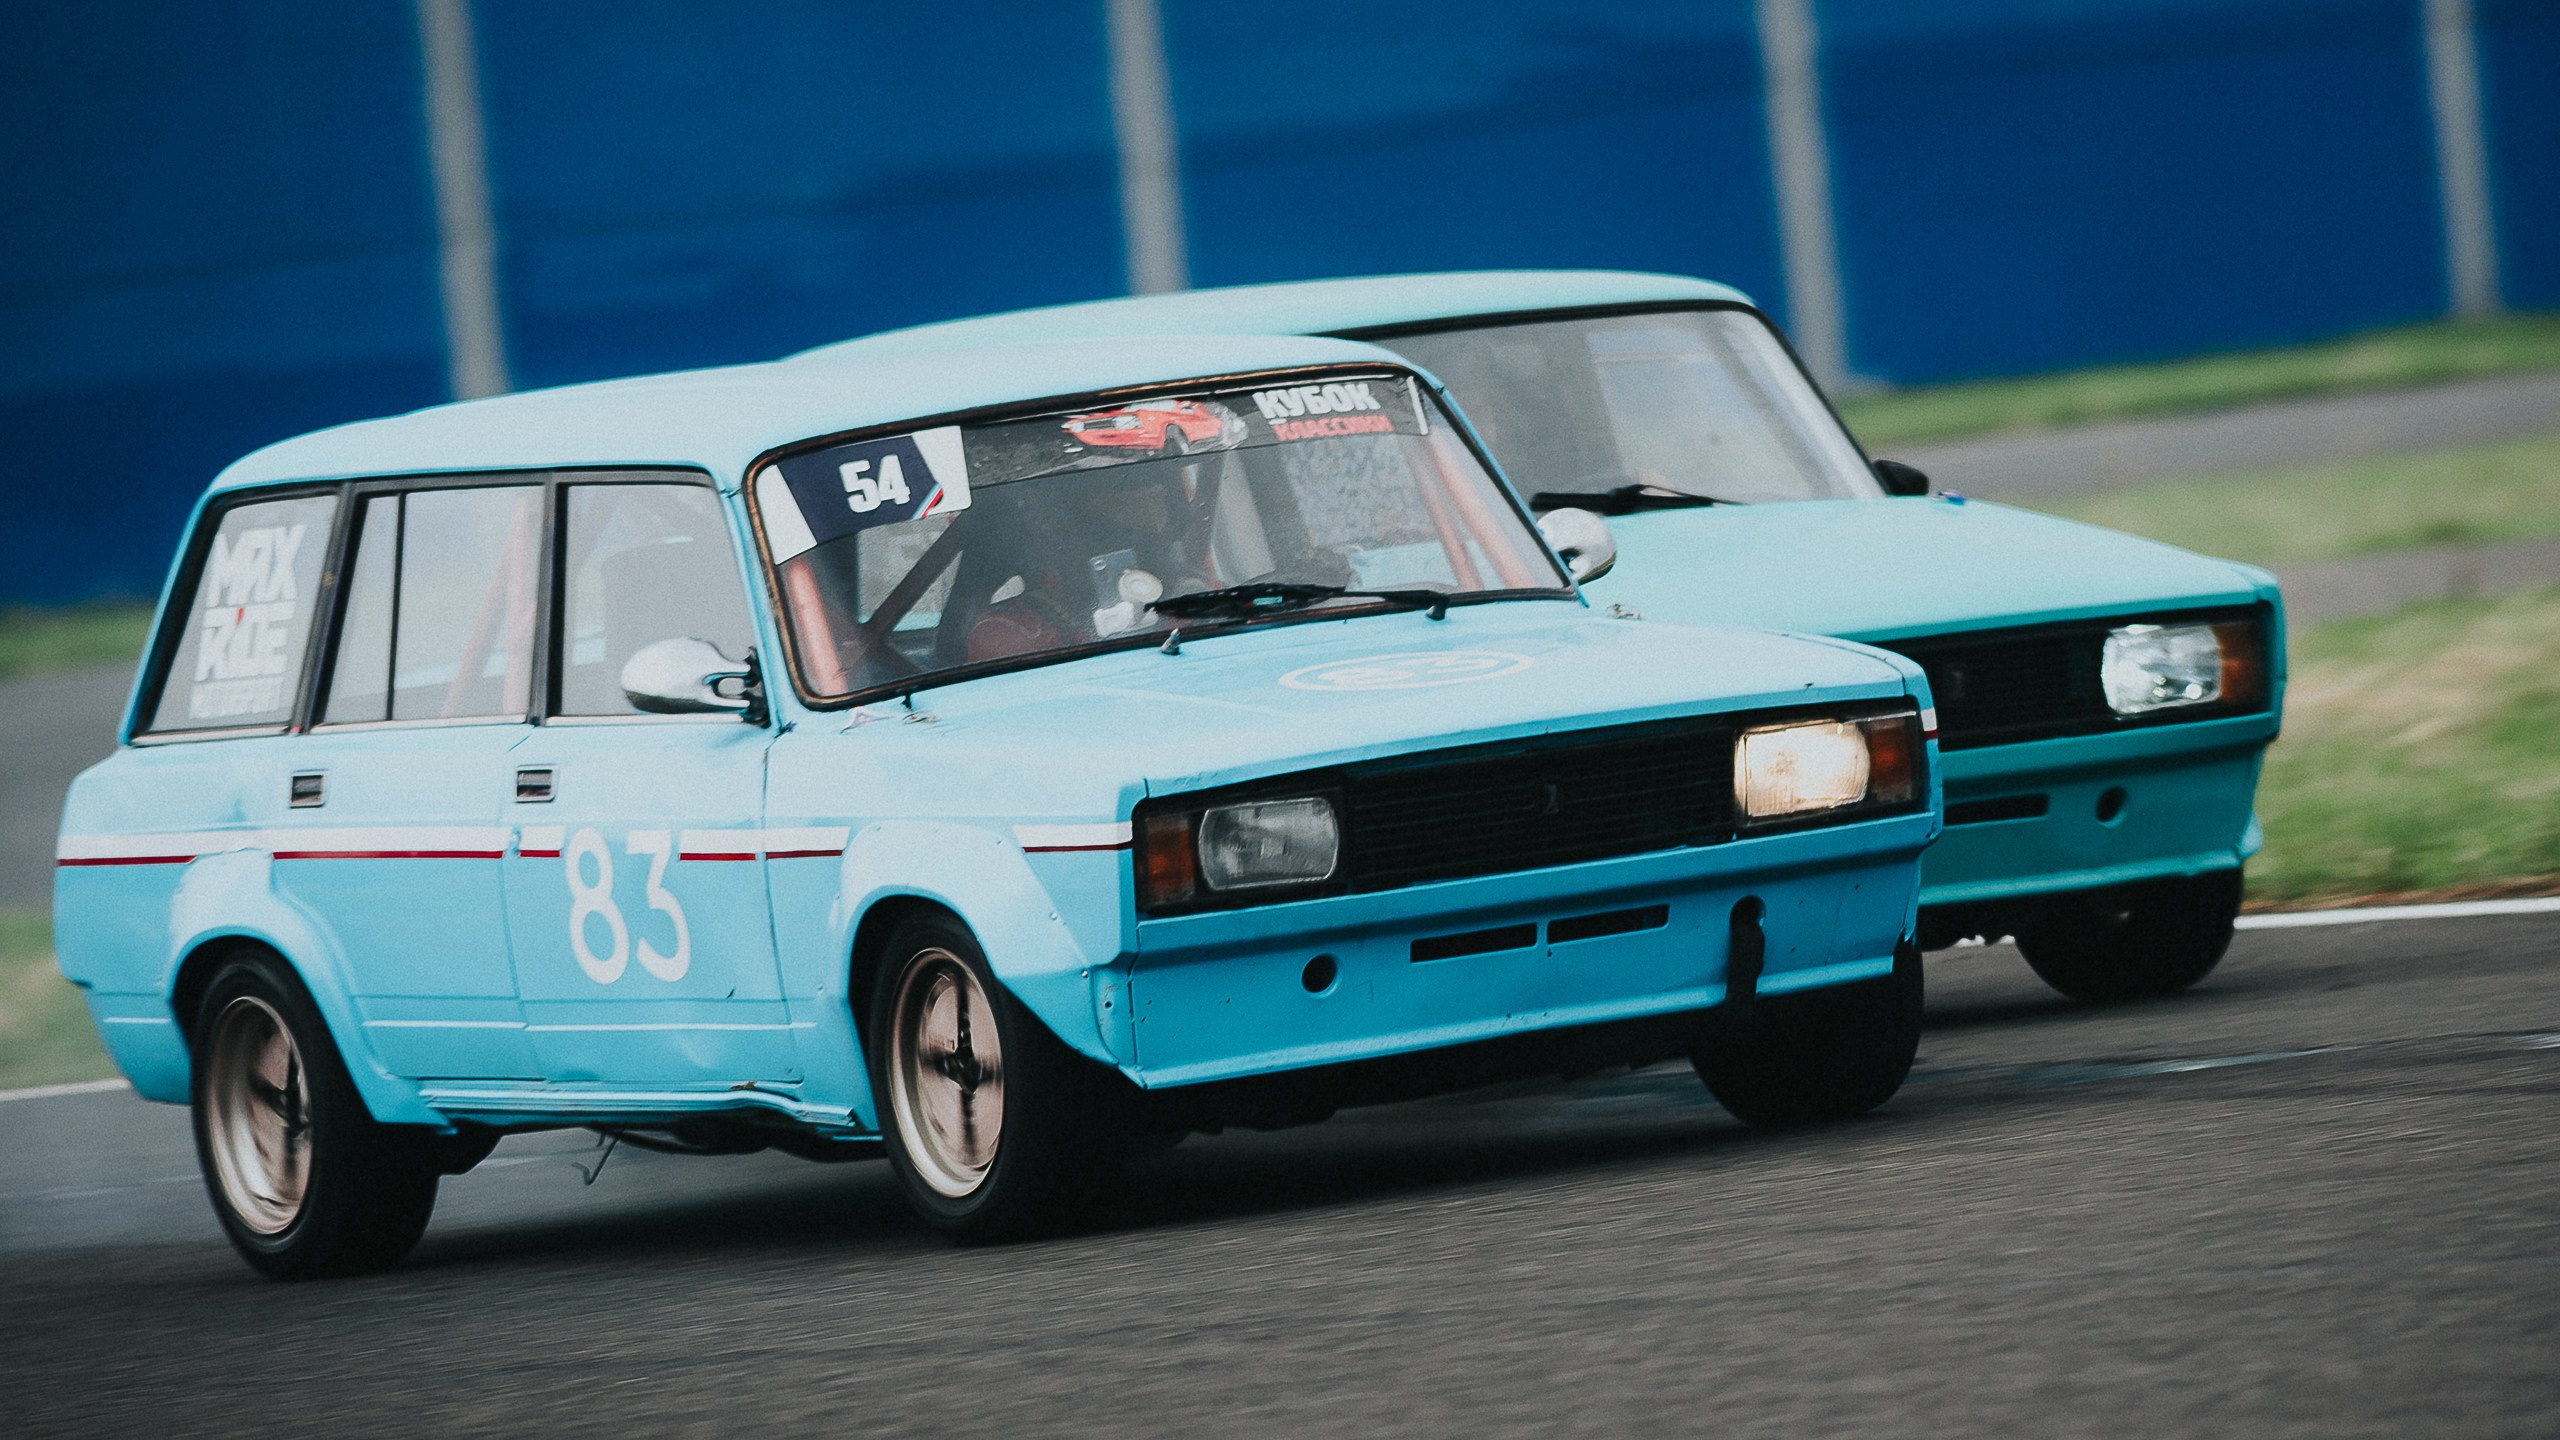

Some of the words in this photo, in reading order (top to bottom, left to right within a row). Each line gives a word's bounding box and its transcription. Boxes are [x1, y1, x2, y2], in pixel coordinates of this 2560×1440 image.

[1252, 382, 1381, 420] КУБОК
[839, 454, 911, 513] 54
[206, 524, 307, 608] MAX
[565, 827, 692, 985] 83
